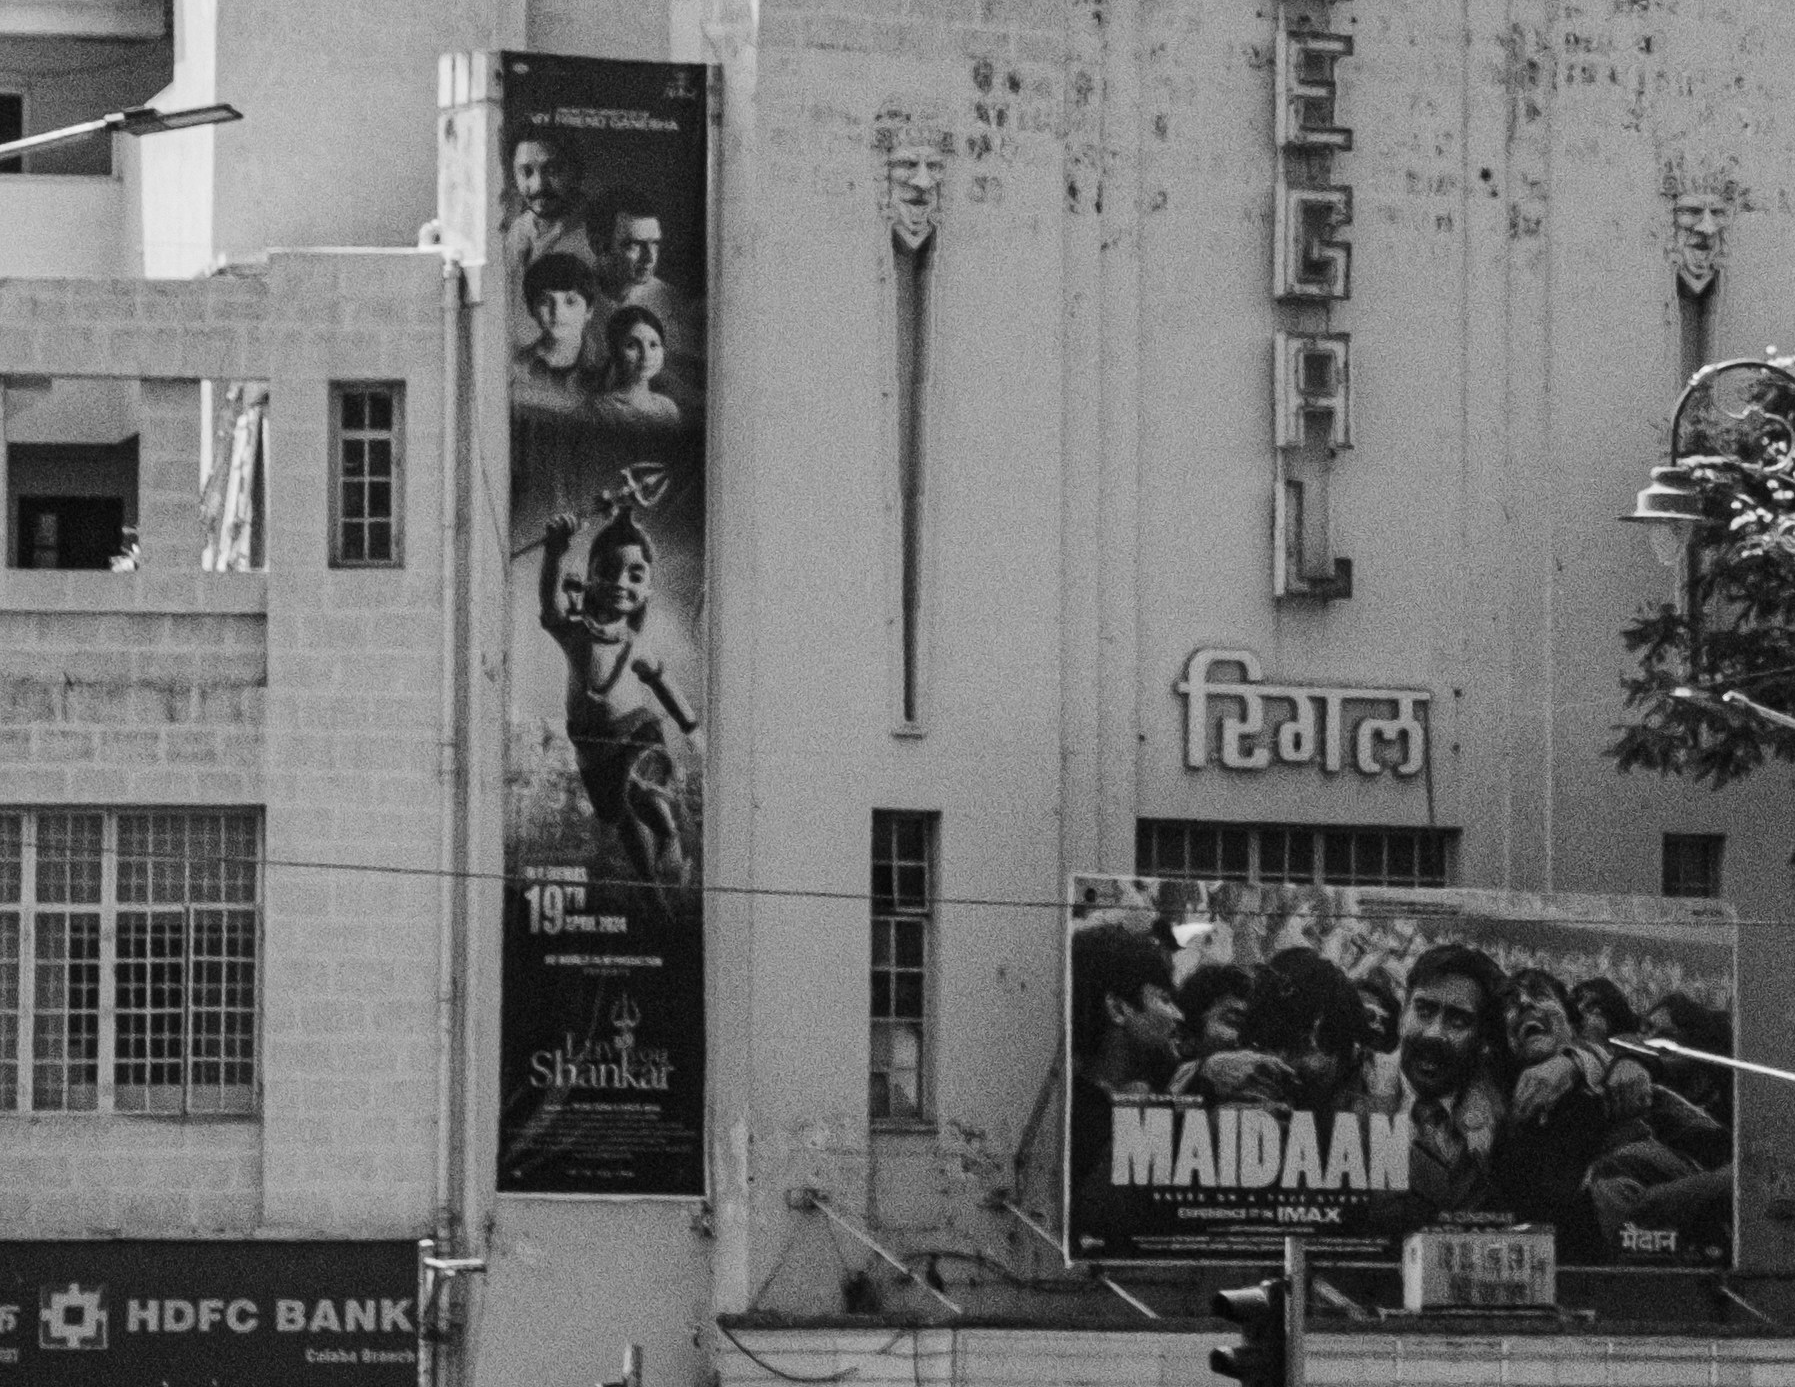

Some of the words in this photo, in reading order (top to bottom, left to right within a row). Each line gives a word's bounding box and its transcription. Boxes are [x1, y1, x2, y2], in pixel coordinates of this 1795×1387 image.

[555, 113, 606, 129] FRIEND
[1175, 647, 1431, 777] रिगल
[530, 1049, 674, 1090] Shankar
[1111, 1106, 1411, 1191] MAIDAAN
[1276, 1205, 1343, 1225] IMAX
[1620, 1221, 1679, 1253] मैदान
[126, 1297, 260, 1334] HDFC
[275, 1297, 415, 1334] BANK
